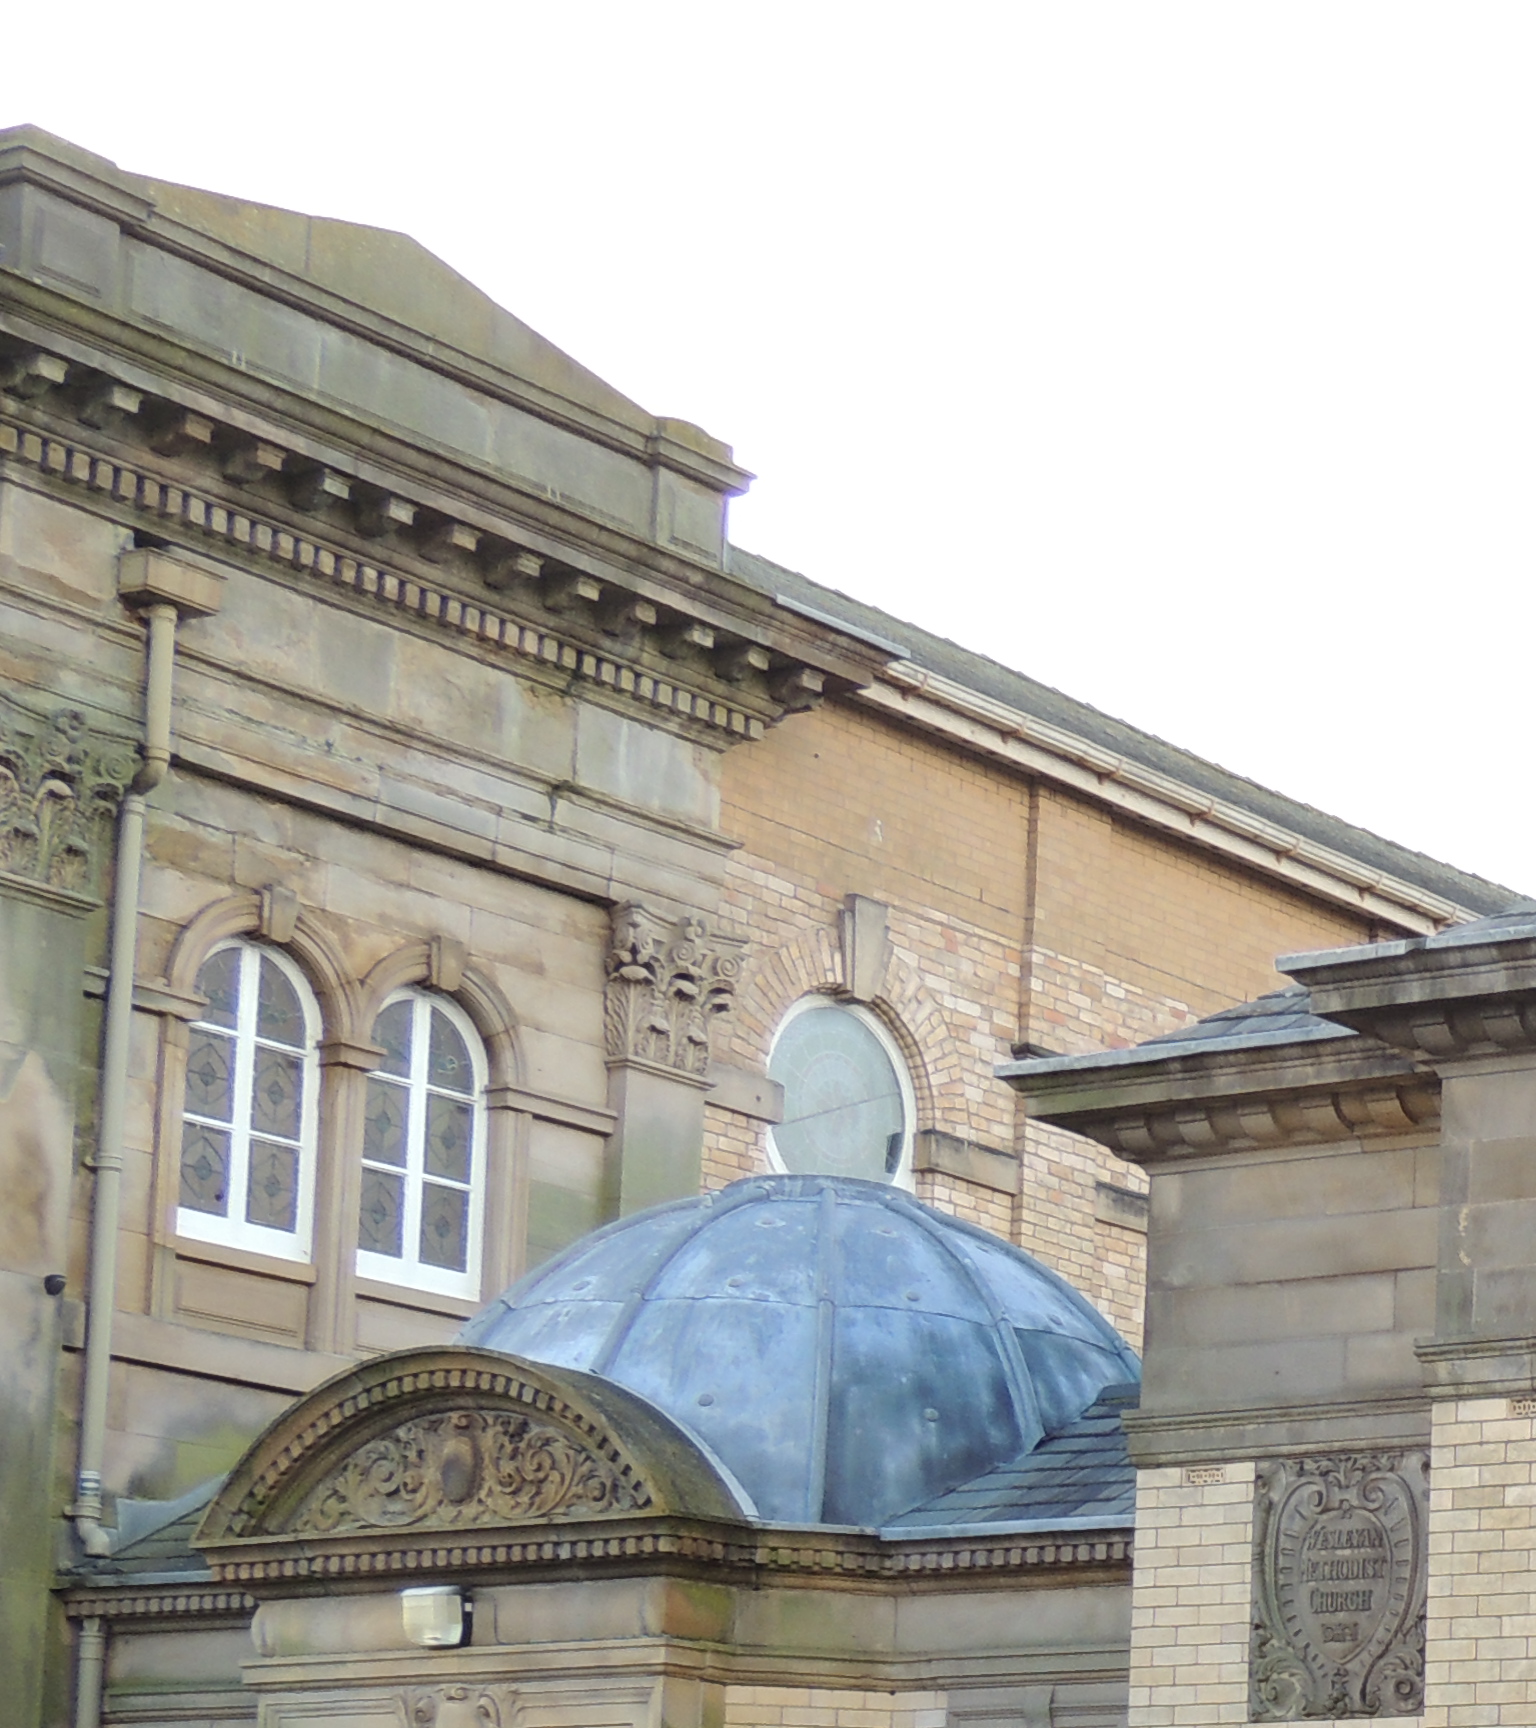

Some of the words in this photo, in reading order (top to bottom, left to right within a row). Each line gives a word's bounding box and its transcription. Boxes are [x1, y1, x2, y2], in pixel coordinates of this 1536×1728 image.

[1306, 1525, 1384, 1551] WESLEYAN
[1300, 1556, 1388, 1583] METHODIST
[1309, 1588, 1374, 1614] CHURCH
